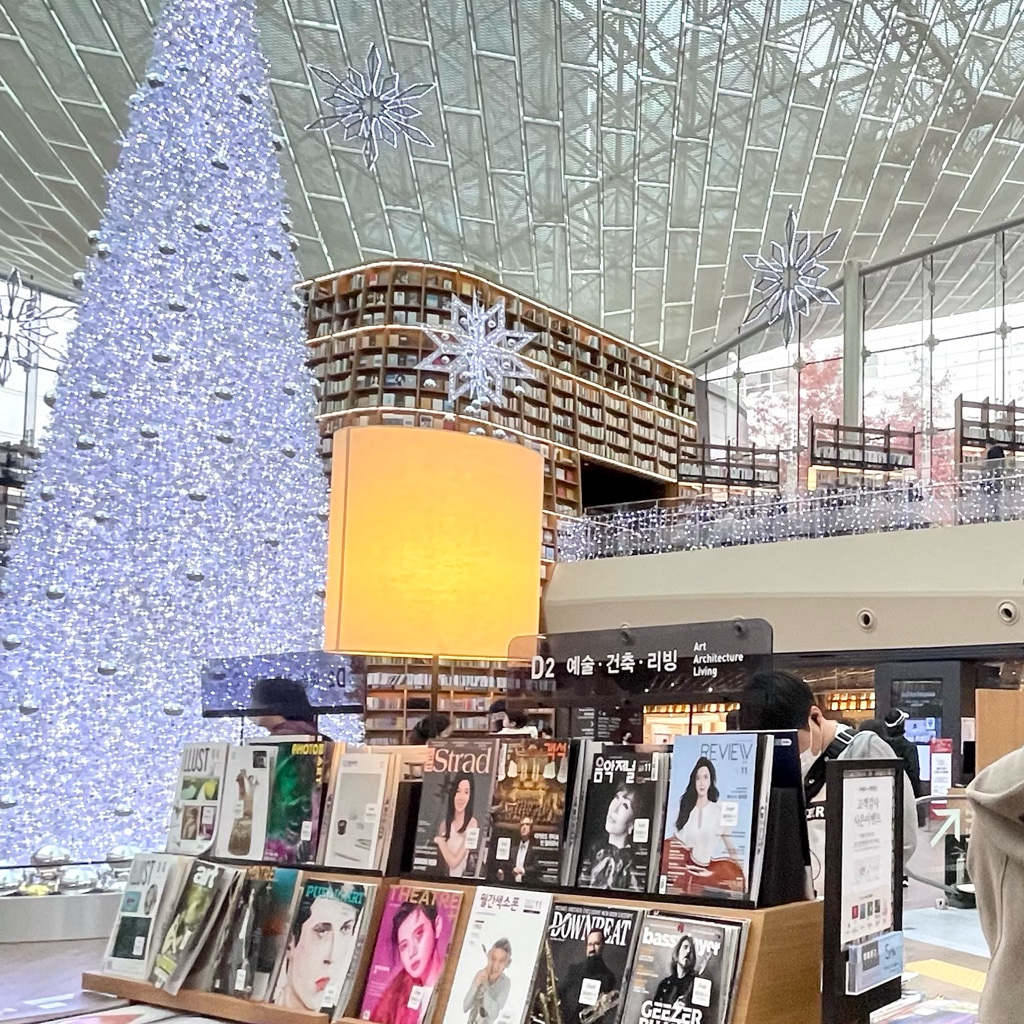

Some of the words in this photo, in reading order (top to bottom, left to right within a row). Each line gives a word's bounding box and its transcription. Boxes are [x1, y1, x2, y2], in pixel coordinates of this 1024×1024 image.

[694, 642, 707, 652] Art
[693, 653, 744, 664] Architecture
[531, 656, 555, 680] D2
[693, 665, 718, 678] Living
[433, 748, 492, 774] Strad
[701, 743, 754, 761] REVIEW
[593, 756, 637, 784] 음악저널
